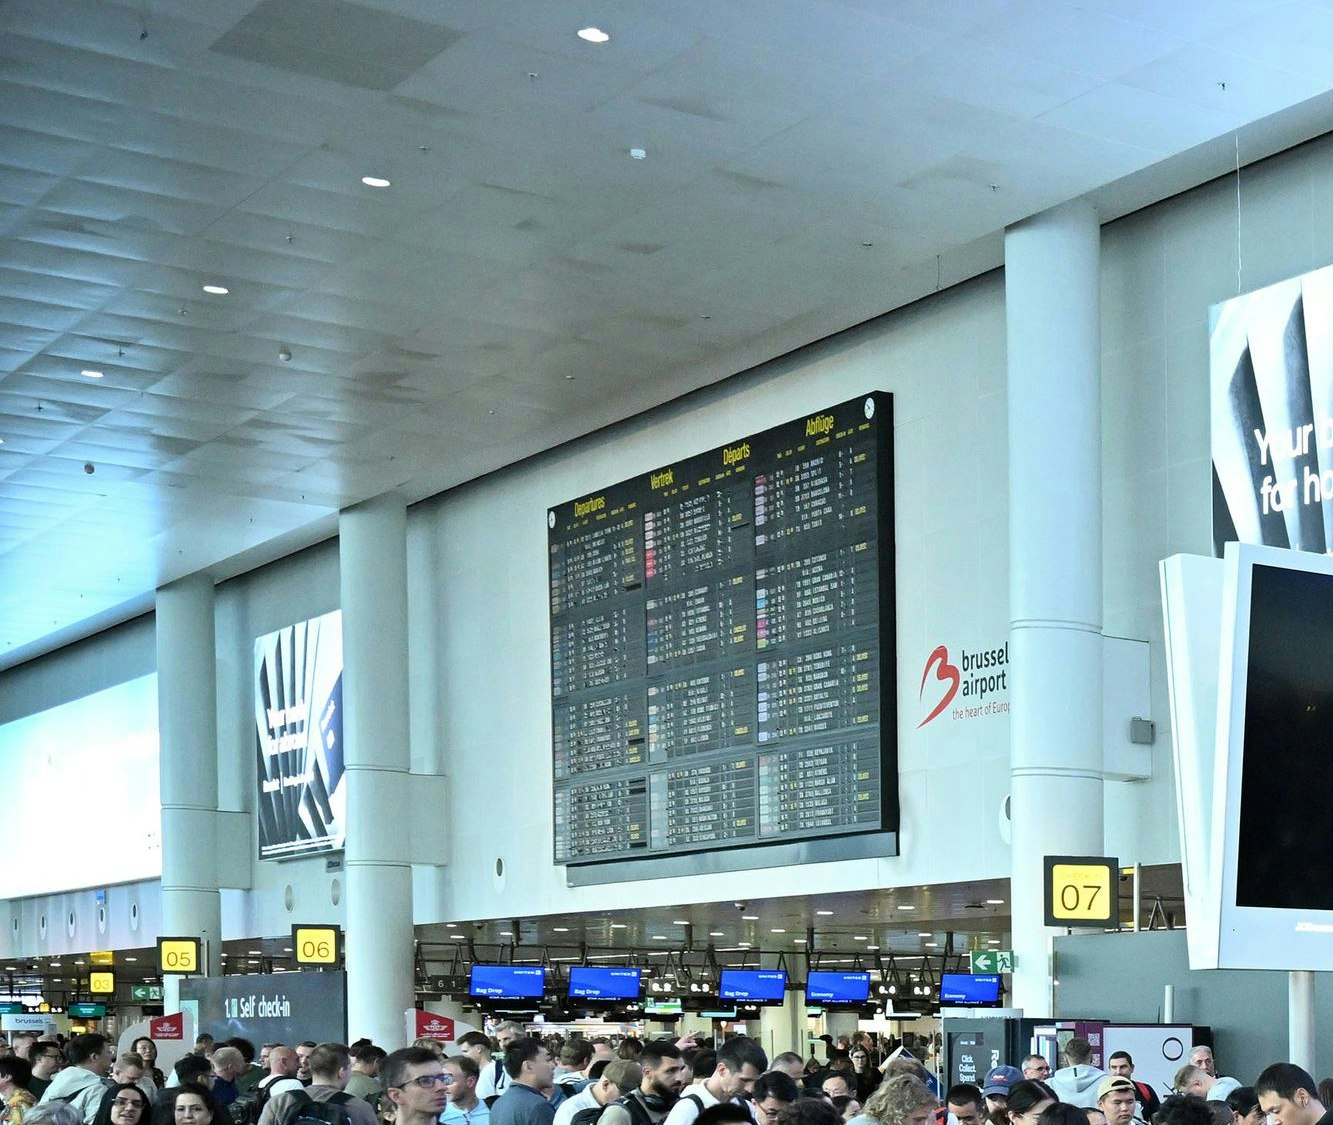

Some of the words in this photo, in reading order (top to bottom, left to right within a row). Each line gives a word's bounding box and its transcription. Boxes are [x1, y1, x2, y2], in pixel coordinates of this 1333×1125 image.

[805, 414, 834, 437] Abflüge
[722, 443, 750, 465] Départs
[1260, 475, 1298, 515] for
[961, 641, 1010, 672] brussel
[962, 669, 1007, 699] airport
[952, 709, 964, 720] the
[965, 706, 984, 719] heart
[984, 702, 992, 716] of
[1061, 884, 1102, 911] 07
[166, 951, 191, 967] 05
[302, 941, 330, 958] 06
[93, 978, 112, 990] 03
[240, 995, 256, 1019] Self
[258, 994, 291, 1018] check-in
